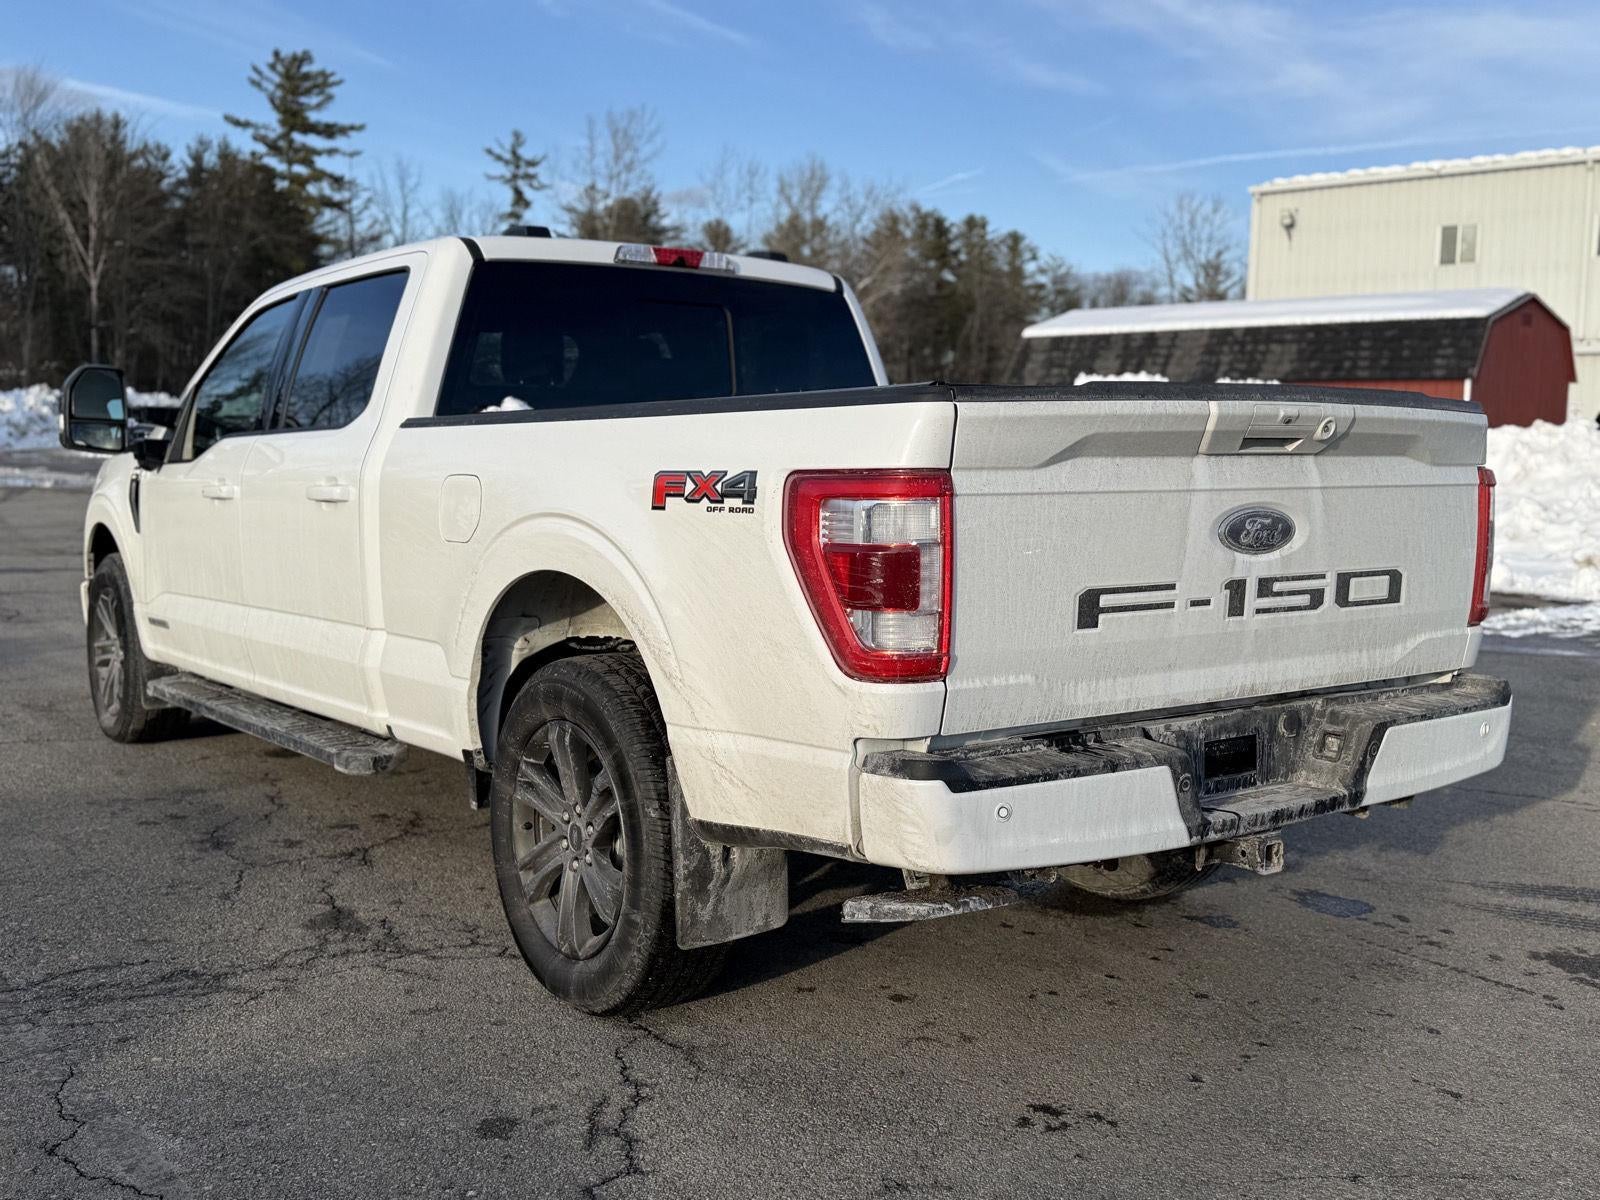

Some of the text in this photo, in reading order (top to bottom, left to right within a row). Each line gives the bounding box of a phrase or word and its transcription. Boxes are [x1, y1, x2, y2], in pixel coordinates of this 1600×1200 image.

[651, 470, 758, 510] FX4
[706, 506, 755, 514] OFF ROAD
[1240, 517, 1283, 545] Ford
[1076, 568, 1403, 630] F-150
